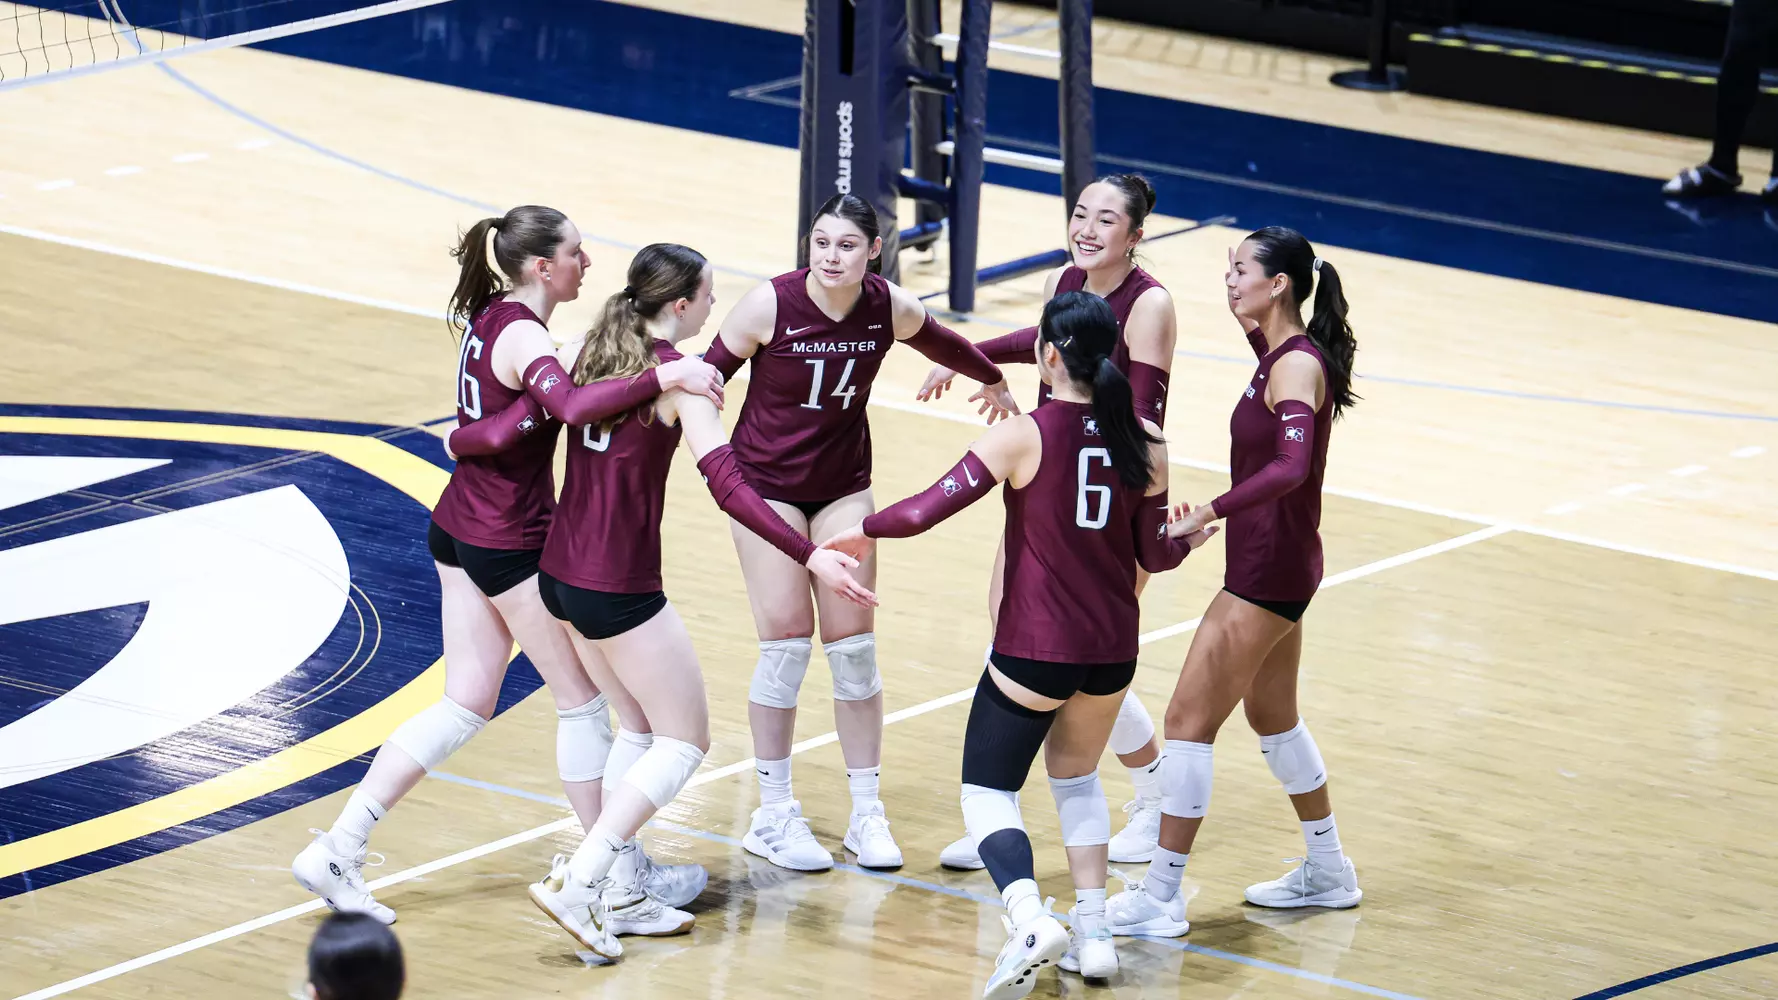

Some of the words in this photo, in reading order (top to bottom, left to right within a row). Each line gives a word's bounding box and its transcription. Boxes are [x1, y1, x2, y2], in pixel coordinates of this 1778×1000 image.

[835, 159, 852, 195] imp
[792, 341, 876, 353] McMASTER
[800, 358, 857, 410] 14
[1076, 447, 1112, 530] 6
